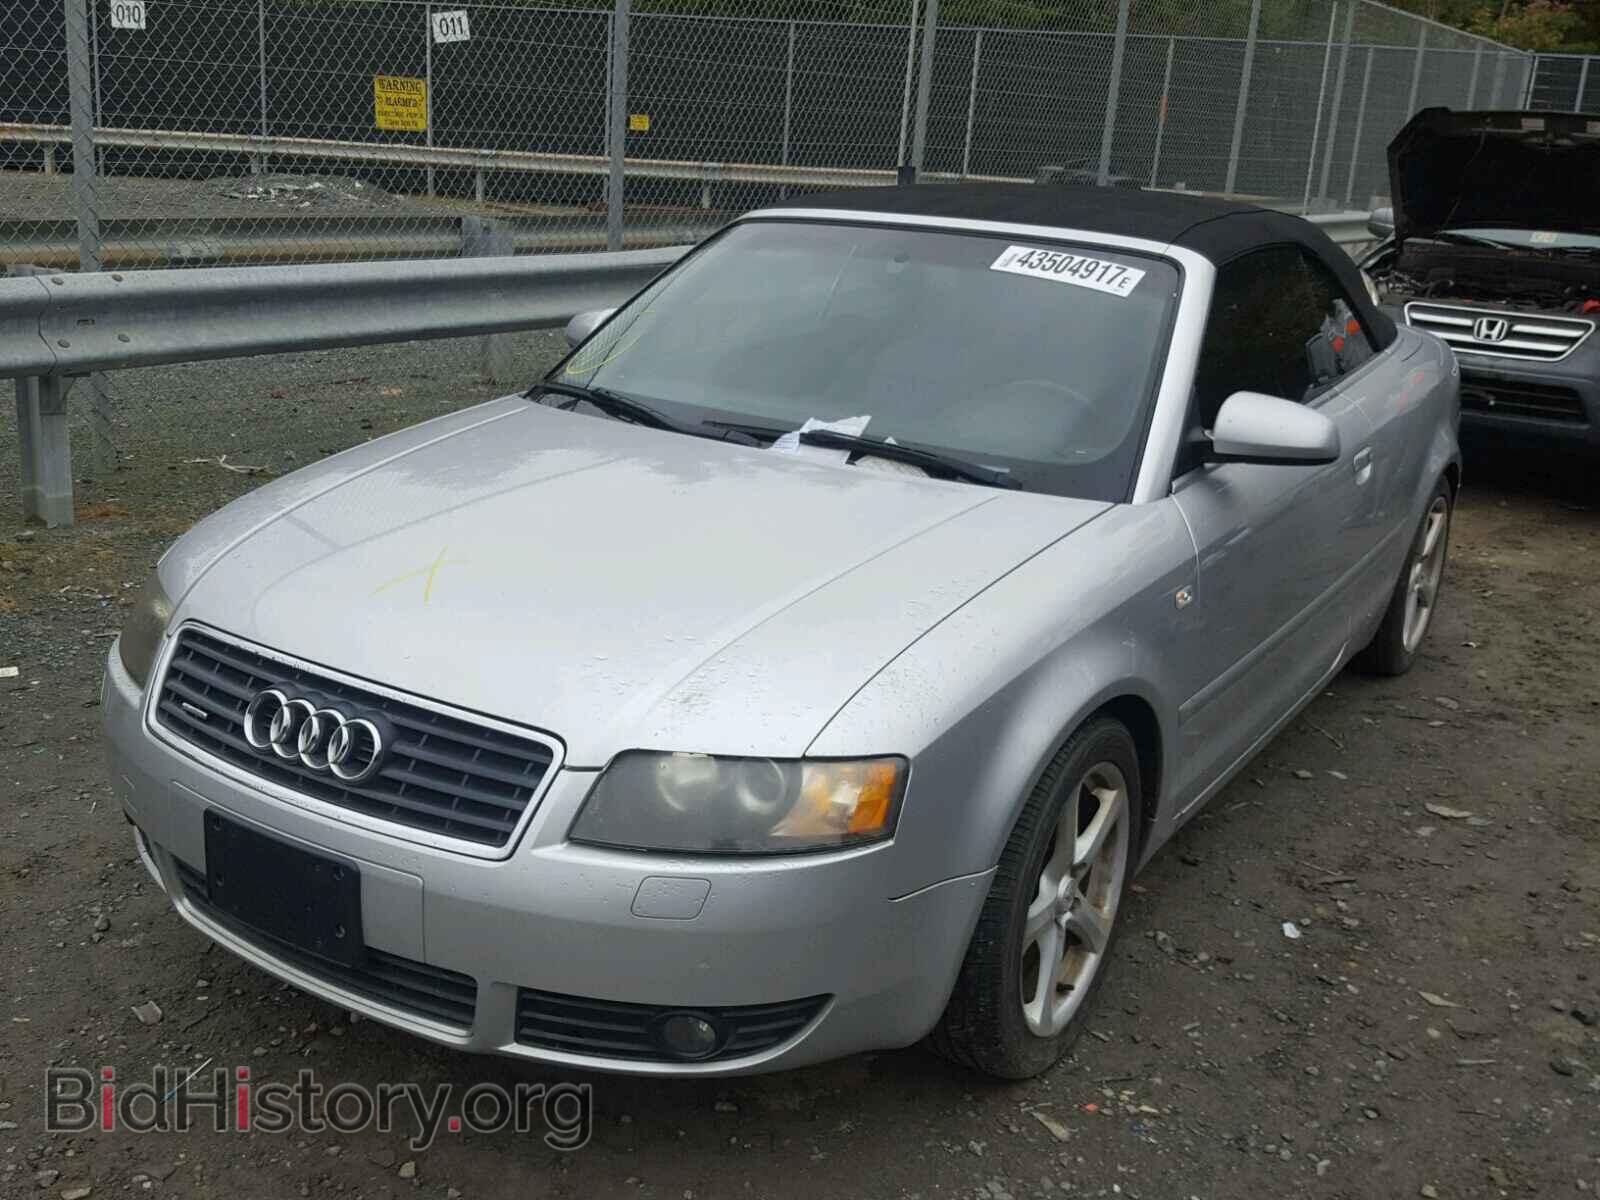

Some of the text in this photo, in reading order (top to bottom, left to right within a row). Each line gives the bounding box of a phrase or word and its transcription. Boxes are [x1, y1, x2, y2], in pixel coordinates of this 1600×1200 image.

[116, 4, 141, 23] 010
[440, 16, 463, 36] 011
[377, 79, 422, 92] WARNING
